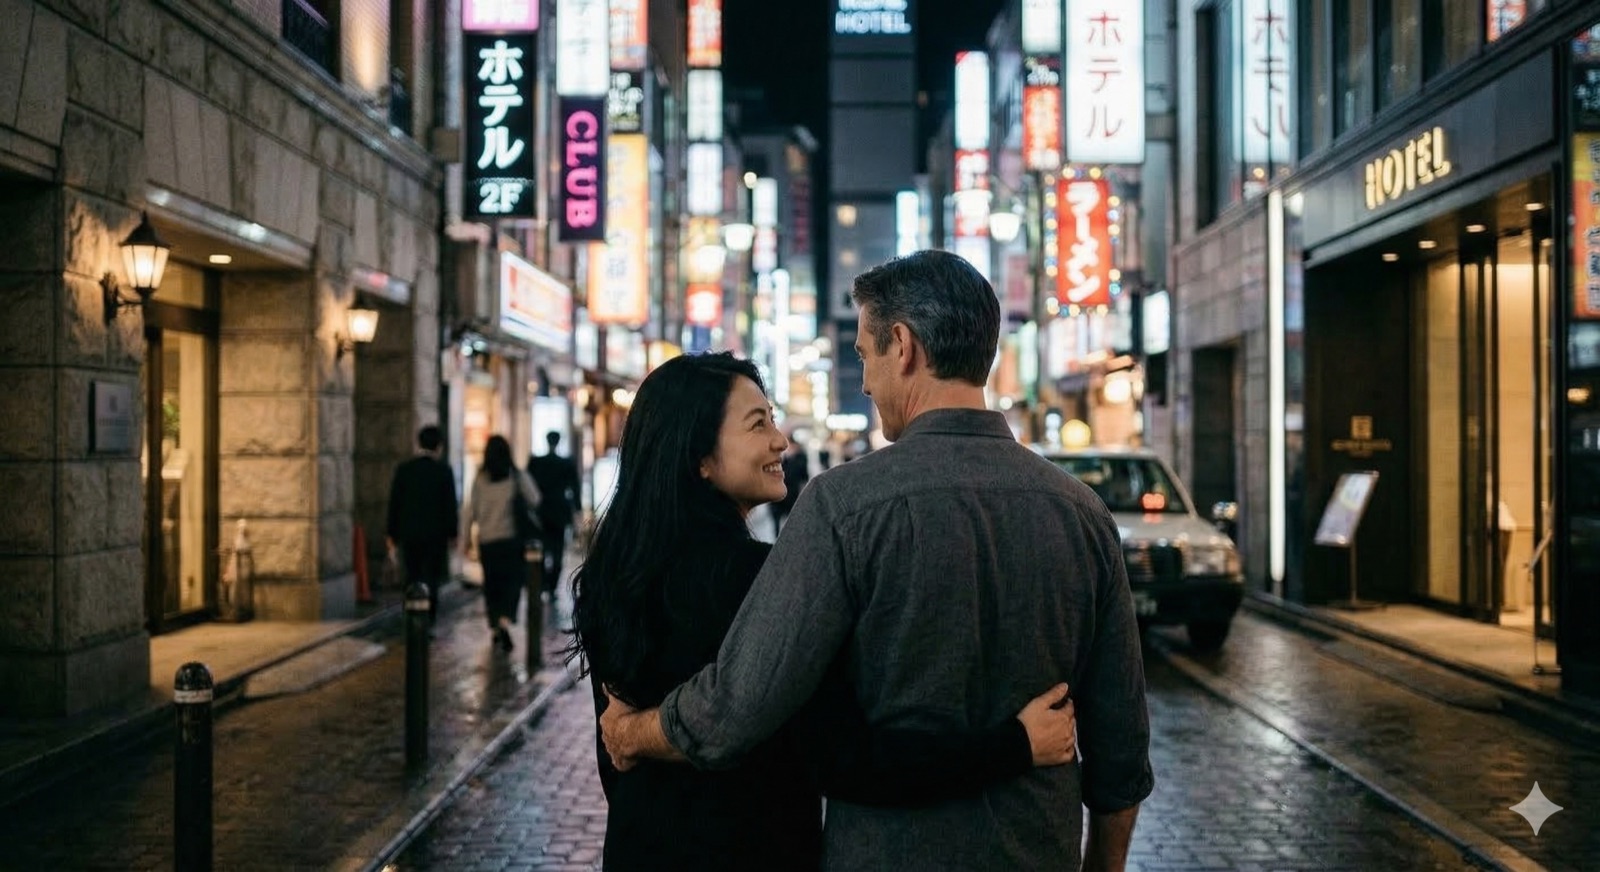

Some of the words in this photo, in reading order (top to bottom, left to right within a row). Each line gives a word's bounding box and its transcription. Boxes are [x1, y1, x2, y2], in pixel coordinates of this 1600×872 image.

[477, 40, 525, 169] ホテル
[1087, 10, 1124, 139] ホテル
[479, 183, 523, 213] 2F
[566, 110, 599, 229] CLUB
[1365, 126, 1451, 210] HOTEL
[1065, 181, 1101, 303] ラーメン
